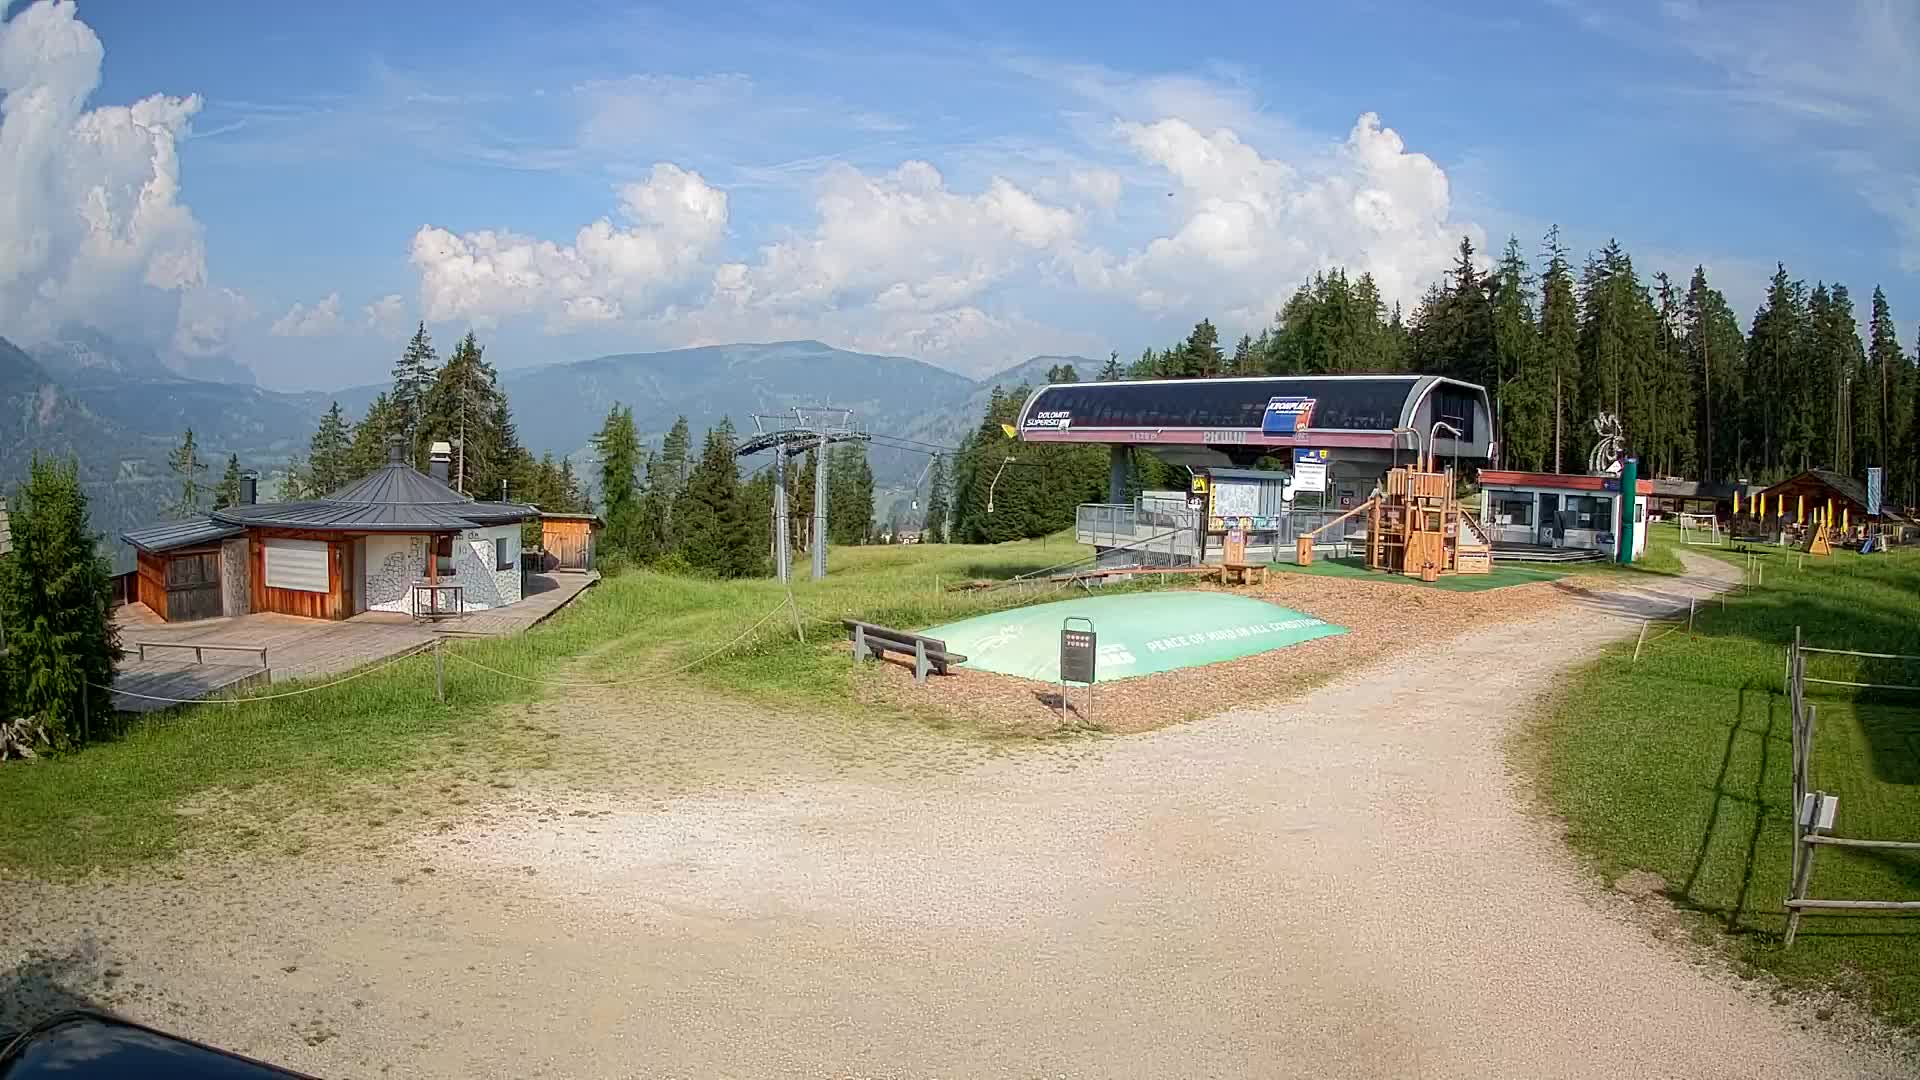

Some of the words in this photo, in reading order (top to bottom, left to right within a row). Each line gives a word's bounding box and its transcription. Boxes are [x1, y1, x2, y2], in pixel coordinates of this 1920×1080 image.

[1038, 411, 1070, 419] DOLOMITI
[1146, 637, 1189, 653] PEACE
[1189, 632, 1206, 645] OF
[1206, 629, 1236, 641] MIND
[1236, 627, 1249, 637] IN
[1249, 624, 1270, 635] ALL
